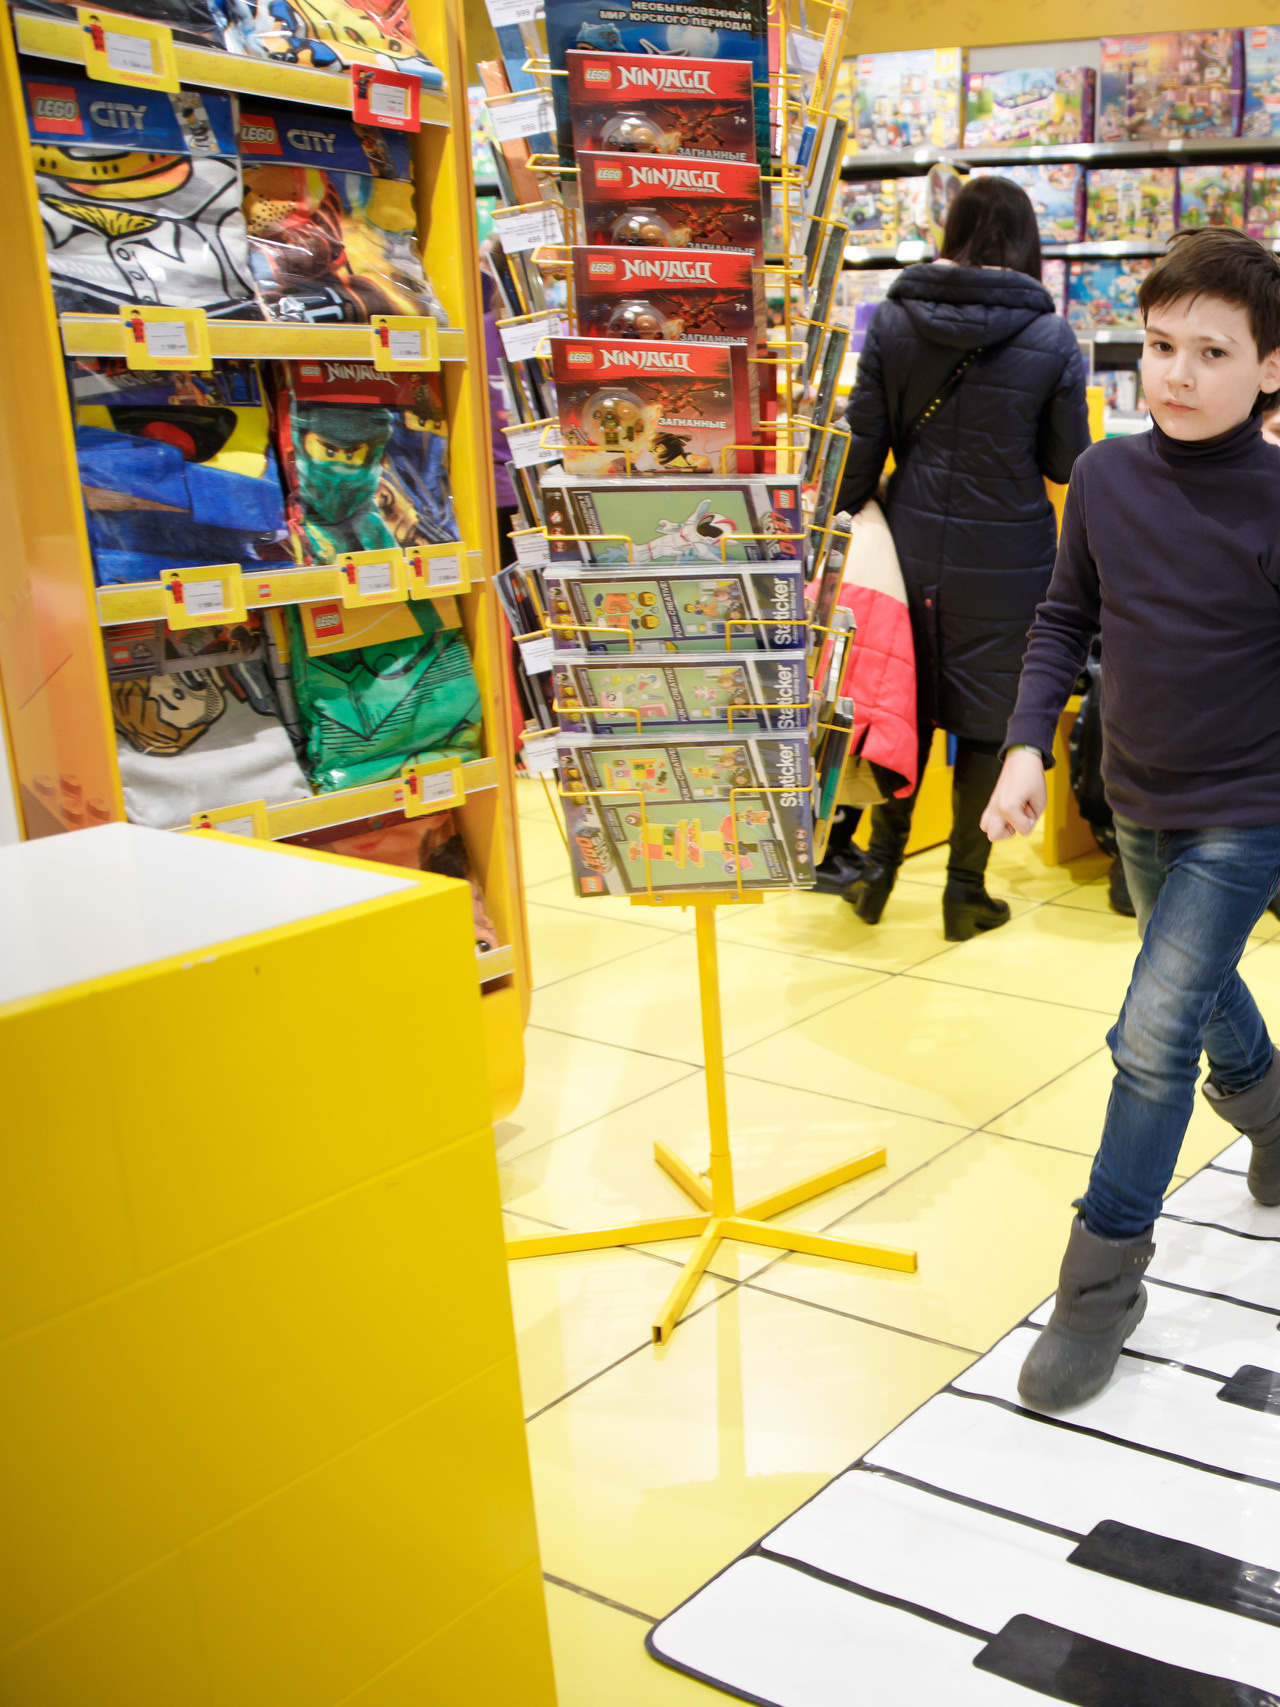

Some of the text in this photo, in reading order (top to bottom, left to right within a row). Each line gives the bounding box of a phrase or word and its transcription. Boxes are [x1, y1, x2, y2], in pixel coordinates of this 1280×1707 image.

[600, 10, 752, 31] МИР ЮРСКОГО ПЕРИОДА!
[631, 0, 752, 21] НЕОБЫКНОВЕННЫЙ
[585, 66, 717, 95] LEGO NINJAGO
[35, 99, 148, 131] LEGO CITY
[733, 116, 747, 125] 7+
[240, 125, 337, 154] LEGO CITY
[676, 147, 747, 161] ЗАГНАННЫЕ
[597, 165, 726, 194] LEGO NINJAGO
[742, 214, 756, 223] 7+
[528, 235, 542, 244] 499
[589, 258, 719, 284] LEGO NINJAGO
[734, 303, 748, 312] 7+
[568, 349, 697, 374] LEGO NINJAGO
[712, 390, 726, 399] 7+
[658, 417, 728, 430] ЗАГНАННЫЕ
[779, 490, 790, 508] LEGO
[770, 577, 793, 645] Staticker
[775, 664, 796, 729] Staticker
[775, 744, 797, 808] Staticker
